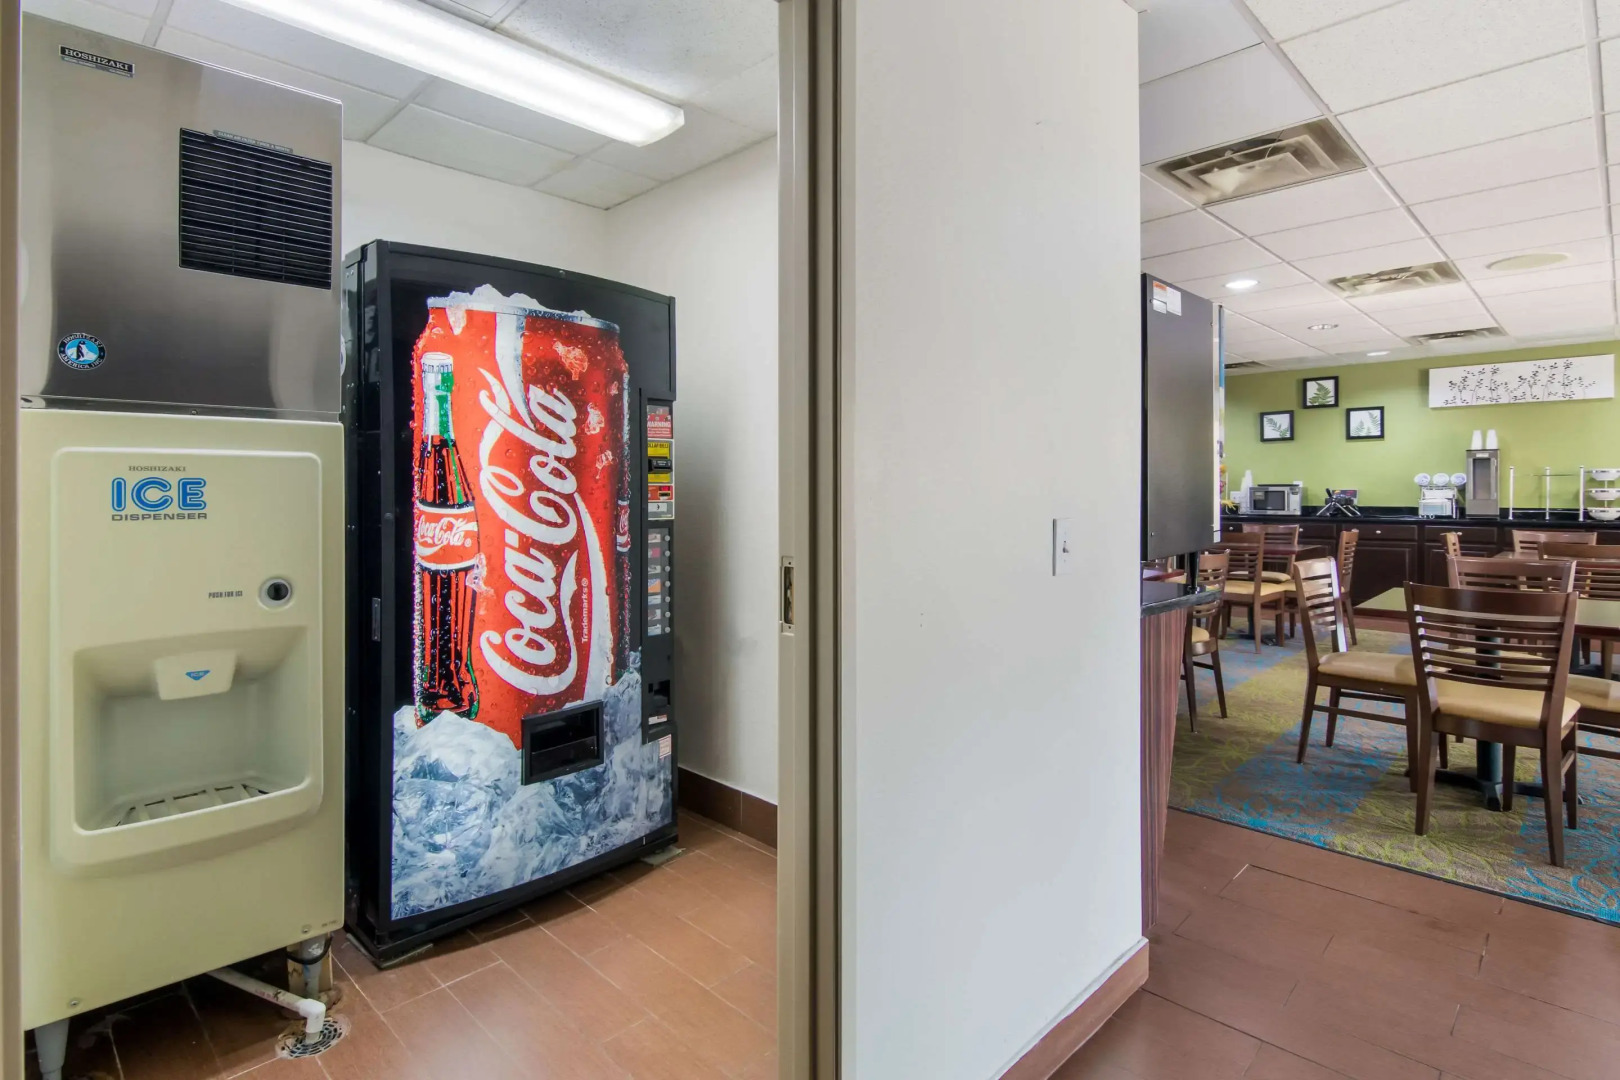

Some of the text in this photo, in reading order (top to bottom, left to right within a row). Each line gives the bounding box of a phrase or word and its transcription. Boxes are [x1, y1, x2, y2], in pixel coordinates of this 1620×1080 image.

[64, 48, 129, 70] HOSHIZAKI
[61, 353, 90, 369] AMERICA
[112, 477, 207, 512] ICE
[111, 512, 207, 521] DISPENSER
[417, 514, 465, 546] Coca-Cola
[480, 376, 579, 696] Coca-Cola
